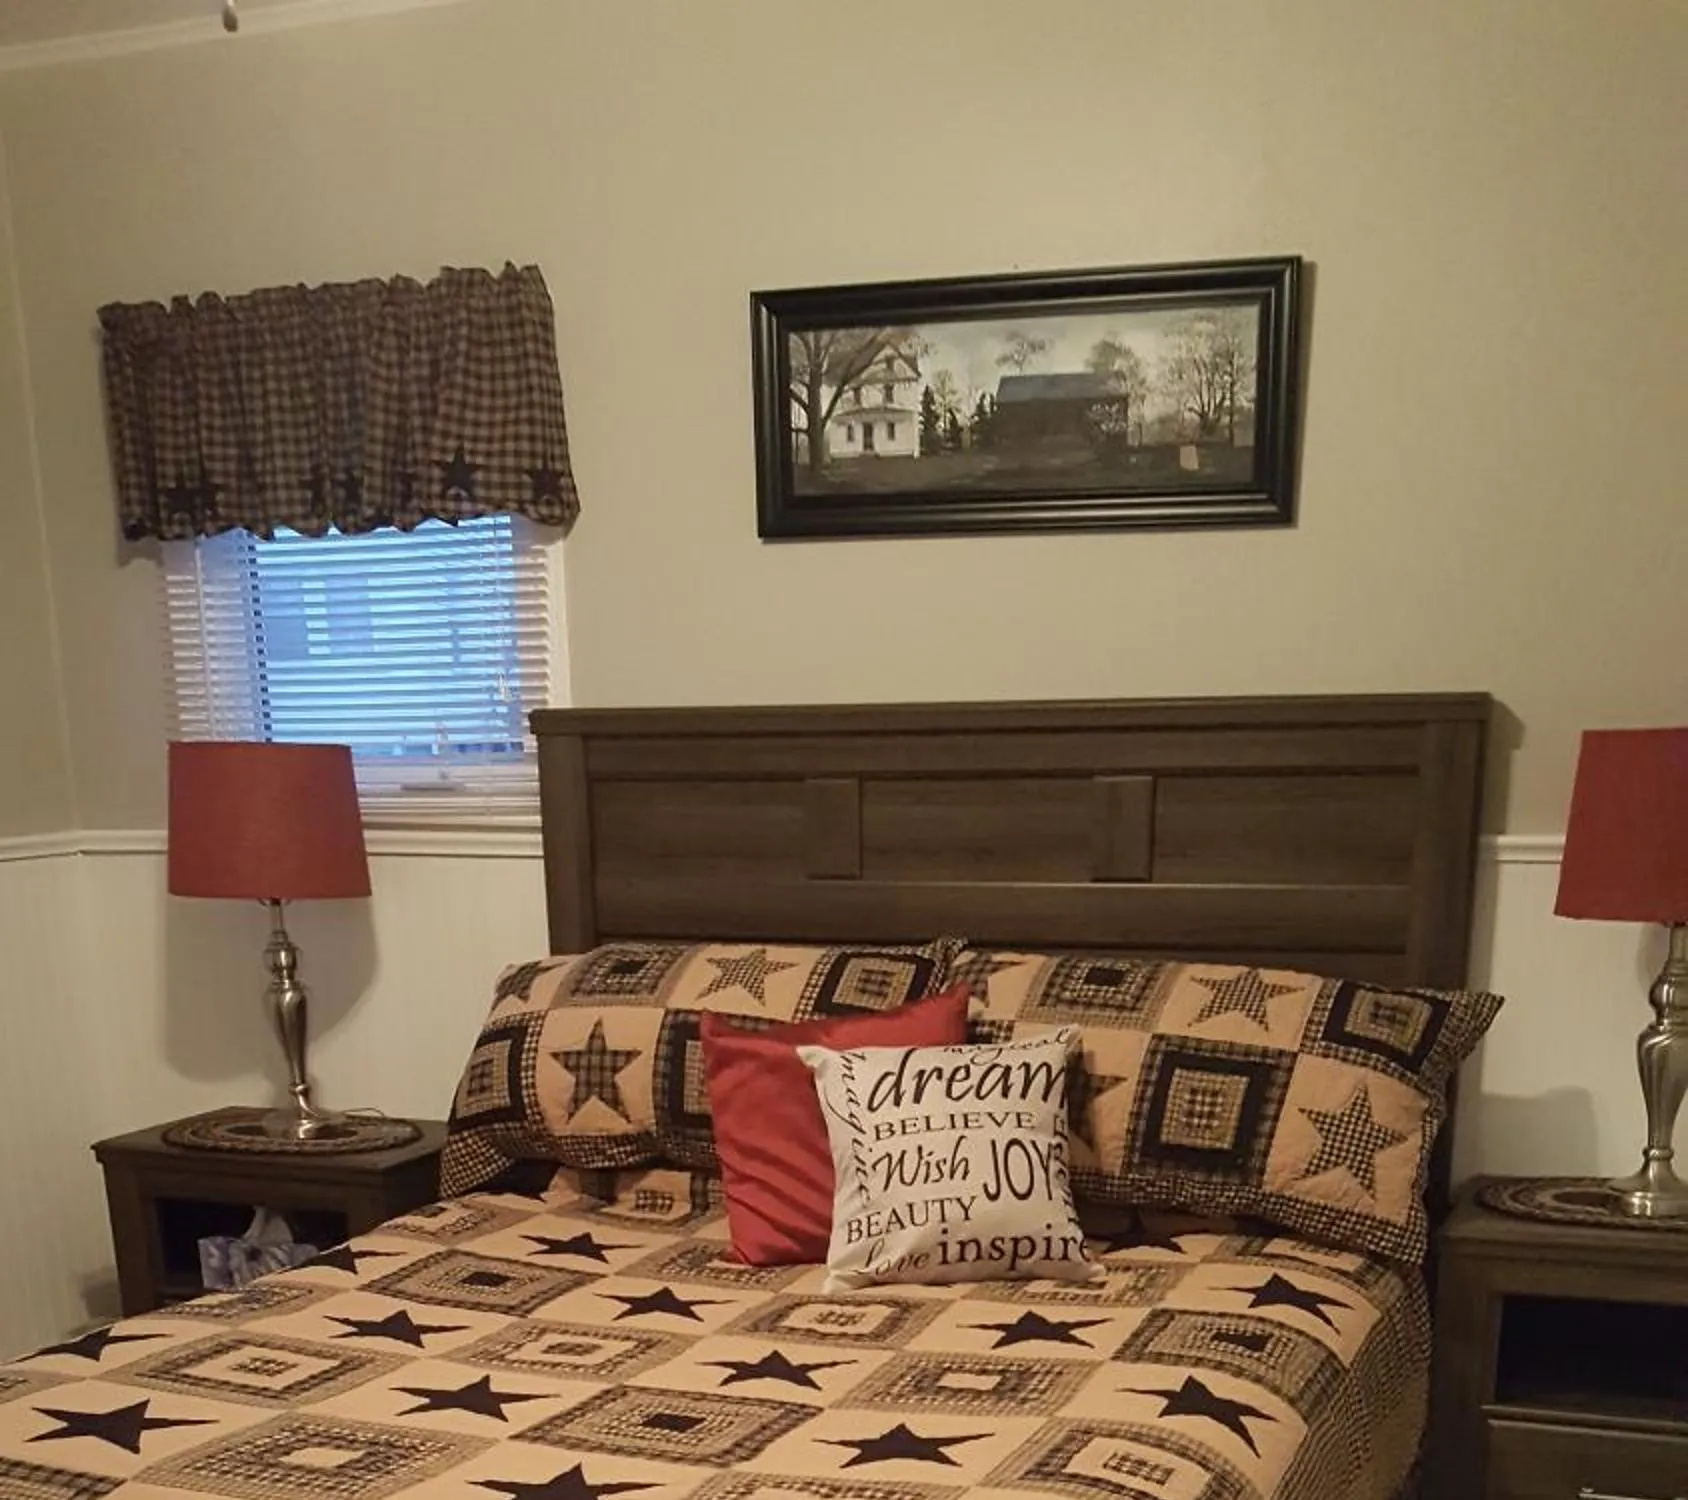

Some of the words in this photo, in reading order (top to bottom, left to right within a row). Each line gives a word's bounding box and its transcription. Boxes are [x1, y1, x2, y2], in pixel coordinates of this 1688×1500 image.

[867, 1048, 1066, 1112] dream
[874, 1111, 1037, 1141] BELIEVE
[871, 1135, 970, 1192] Wish
[983, 1138, 1054, 1201] JOY
[846, 1196, 977, 1244] BEAUTY
[938, 1223, 1091, 1271] inspire
